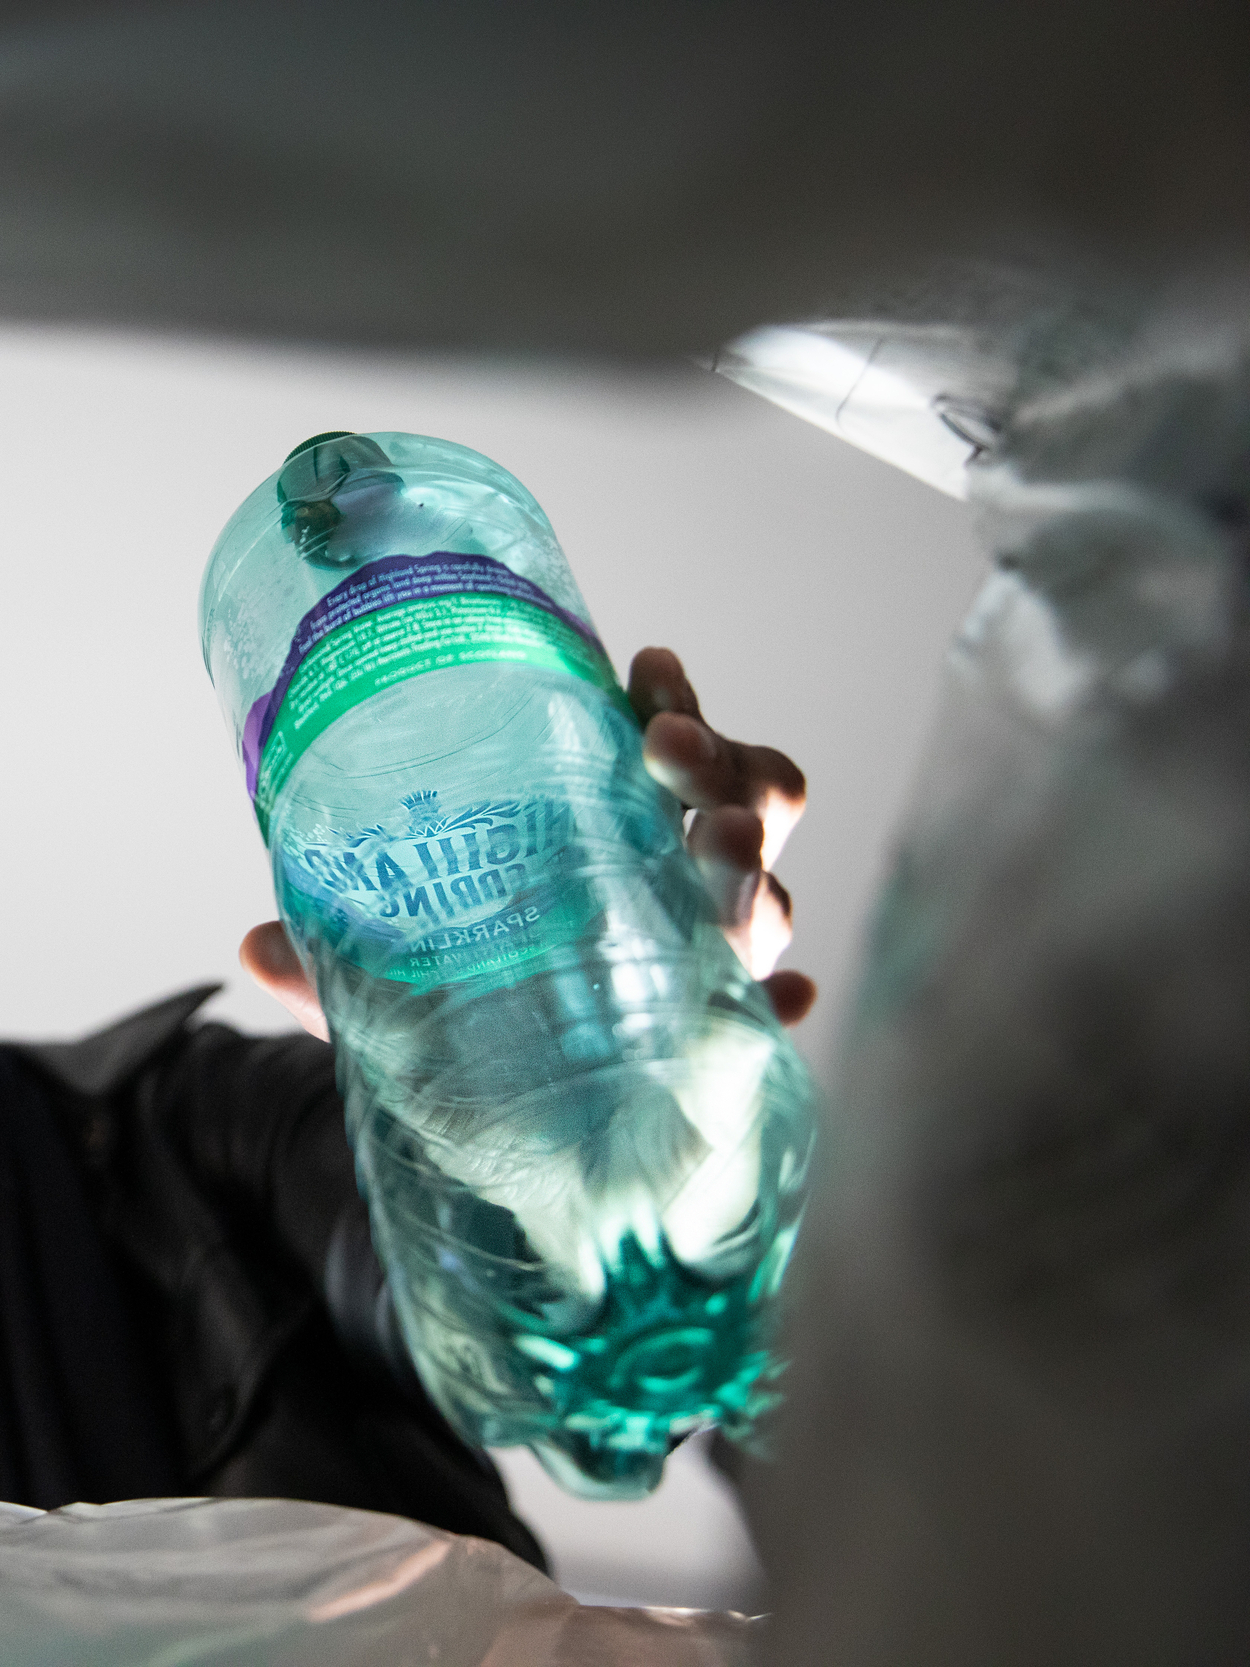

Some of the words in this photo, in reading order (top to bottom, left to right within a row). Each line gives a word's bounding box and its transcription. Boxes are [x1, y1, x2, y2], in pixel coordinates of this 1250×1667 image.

[326, 590, 348, 607] Every
[349, 582, 367, 597] drop
[368, 575, 377, 587] of
[377, 566, 414, 582] Highland
[414, 563, 442, 575] Spring
[342, 607, 352, 622] of
